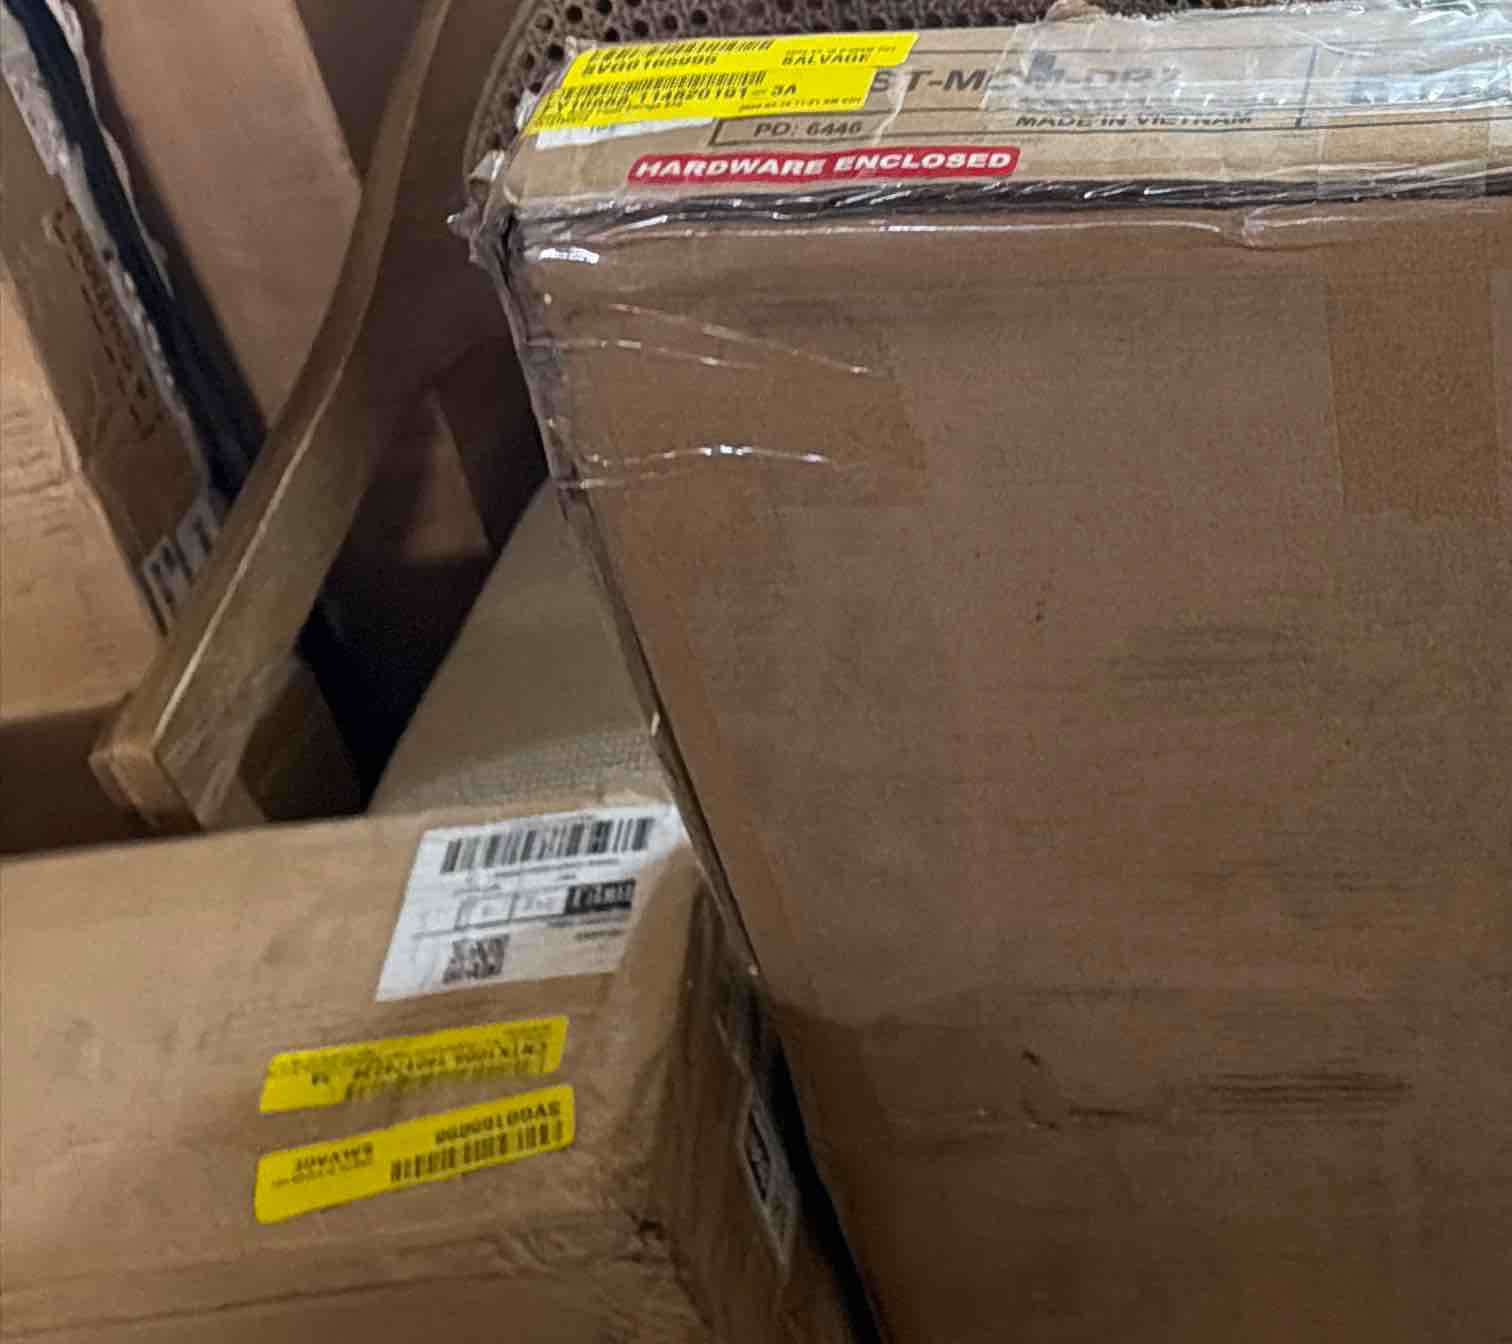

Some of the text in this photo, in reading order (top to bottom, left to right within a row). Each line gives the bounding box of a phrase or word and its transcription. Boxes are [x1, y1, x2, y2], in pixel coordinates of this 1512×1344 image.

[1016, 116, 1092, 128] MADE
[1102, 114, 1127, 127] IN
[754, 122, 798, 138] PO:
[636, 152, 1011, 177] HARDWARE ENCLOSED
